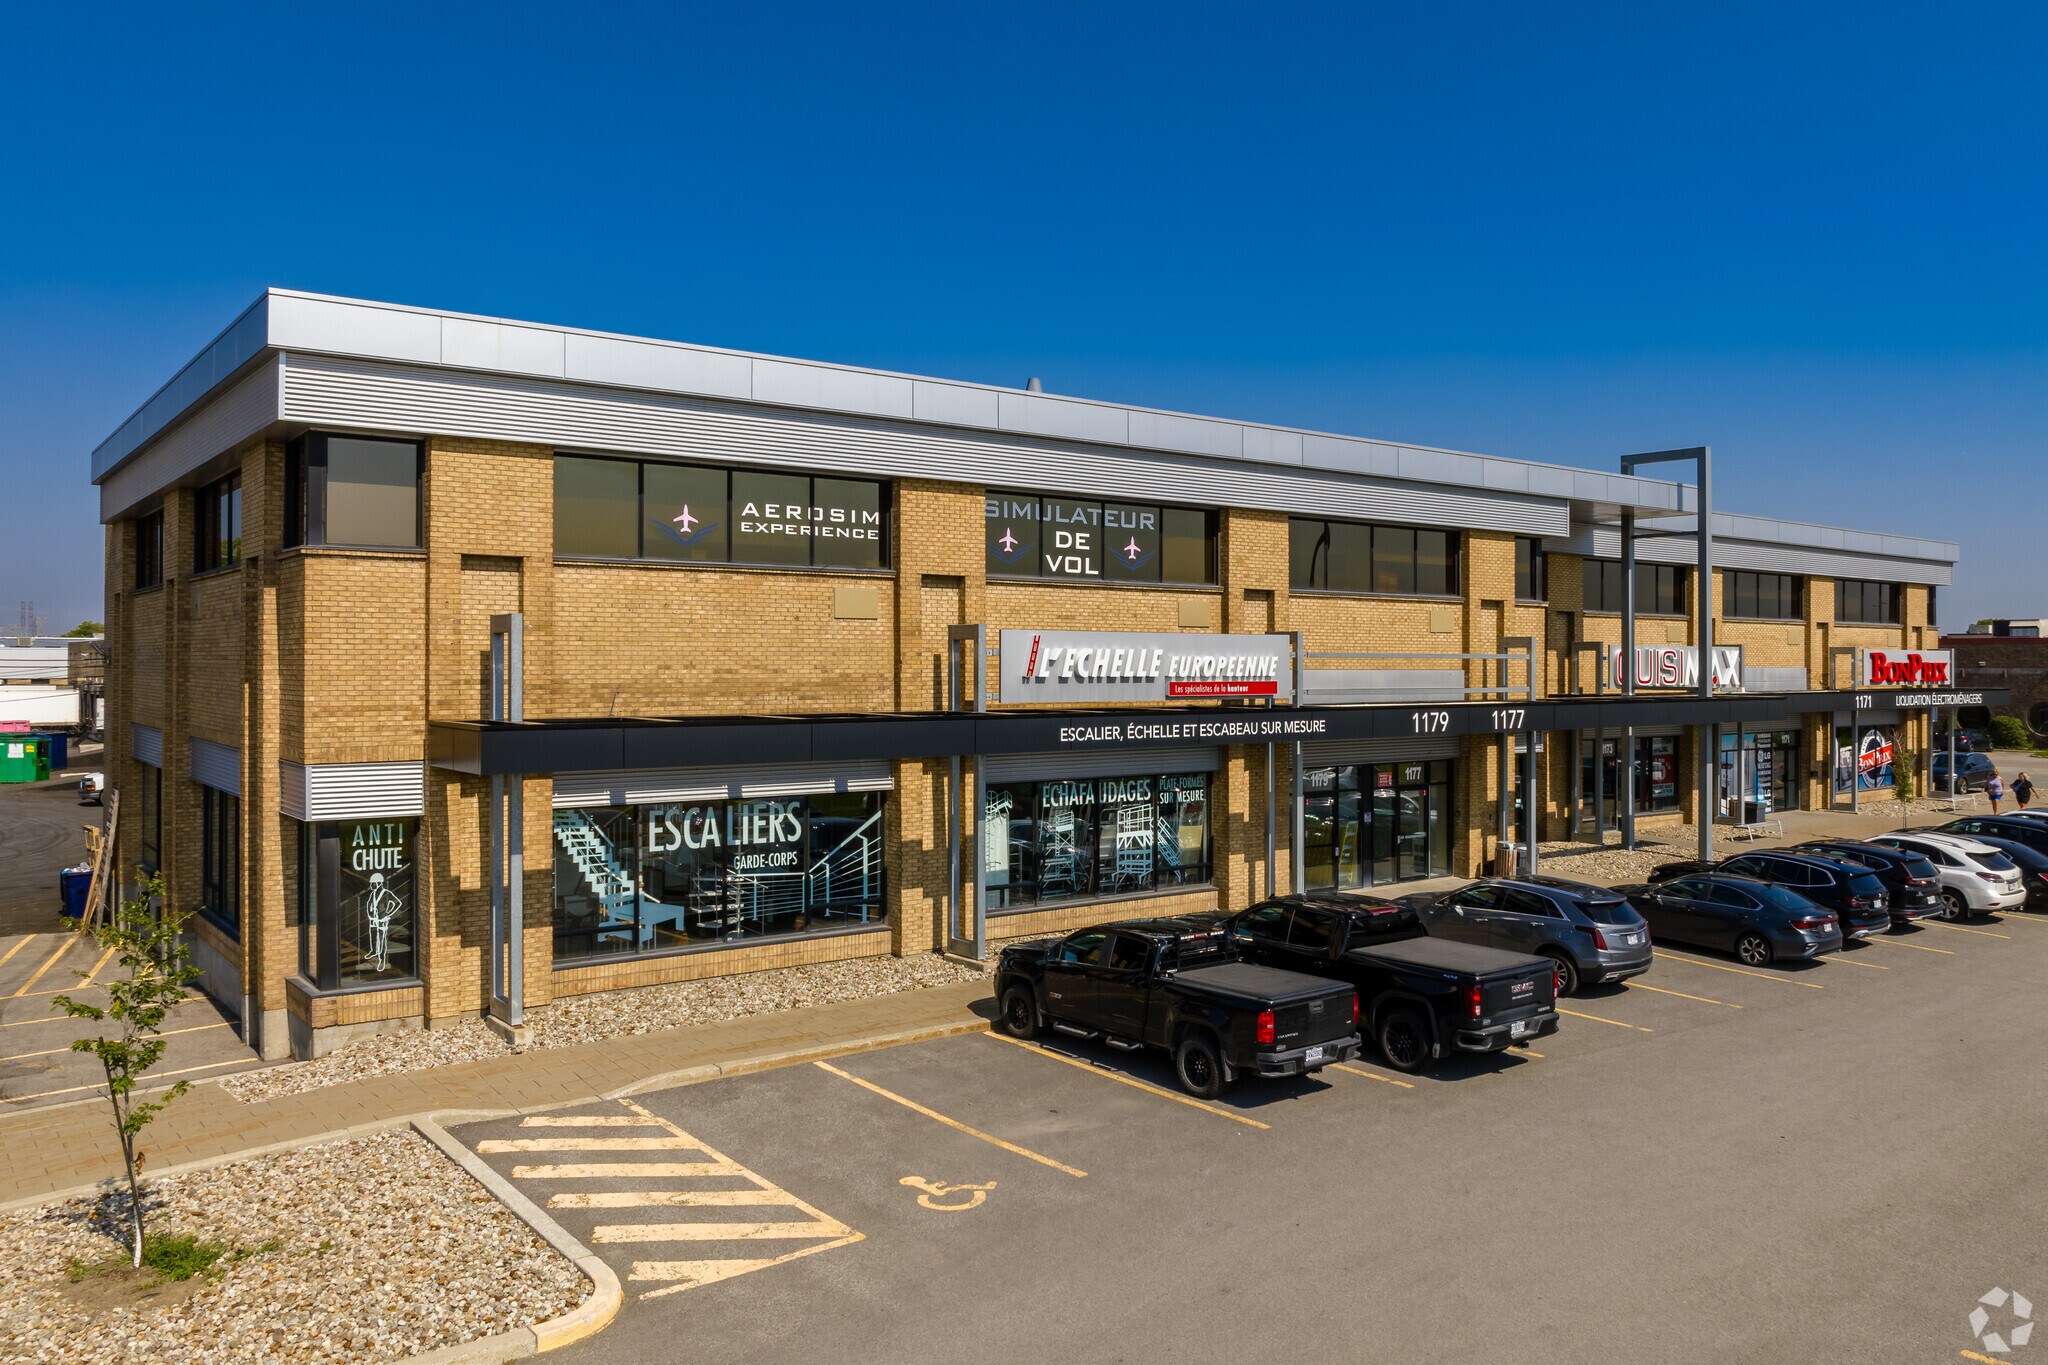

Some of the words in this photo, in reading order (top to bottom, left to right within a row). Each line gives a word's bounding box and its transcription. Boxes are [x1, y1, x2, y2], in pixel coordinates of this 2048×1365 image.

[741, 502, 880, 525] AEROSIM
[985, 499, 1155, 531] SIMULATEUR
[740, 521, 879, 540] EXPERIENCE
[1055, 530, 1090, 550] DE
[1045, 554, 1099, 575] VOL
[1168, 655, 1278, 677] EUROPEENNE
[1174, 684, 1184, 693] Les
[1184, 684, 1213, 695] spécialistes
[1213, 683, 1220, 692] de
[1221, 684, 1226, 692] la
[1227, 683, 1249, 692] hauteur
[1896, 694, 1931, 706] LIQUIDATION
[1932, 692, 1982, 705] ÉLECTROMÉNAGERS
[1855, 695, 1872, 708] 1171
[1412, 711, 1450, 733] 1179
[1491, 709, 1525, 730] 1177
[1060, 726, 1124, 743] ESCALIER,
[1127, 721, 1180, 739] ÉCHELLE
[1182, 724, 1198, 738] ET
[1199, 720, 1259, 738] ESCABEAU
[1260, 720, 1283, 735] SUR
[1284, 719, 1327, 734] MESURE
[1159, 775, 1204, 790] PLATE-FORMES
[1310, 772, 1329, 787] 1179
[1405, 766, 1422, 780] 1177
[1159, 791, 1174, 804] SUR
[1175, 789, 1204, 803] MESURE
[351, 822, 403, 847] ANTI
[649, 801, 802, 852] ESCALIERS
[352, 847, 403, 871] CHUTE
[733, 851, 798, 871] GARDE-CORPS
